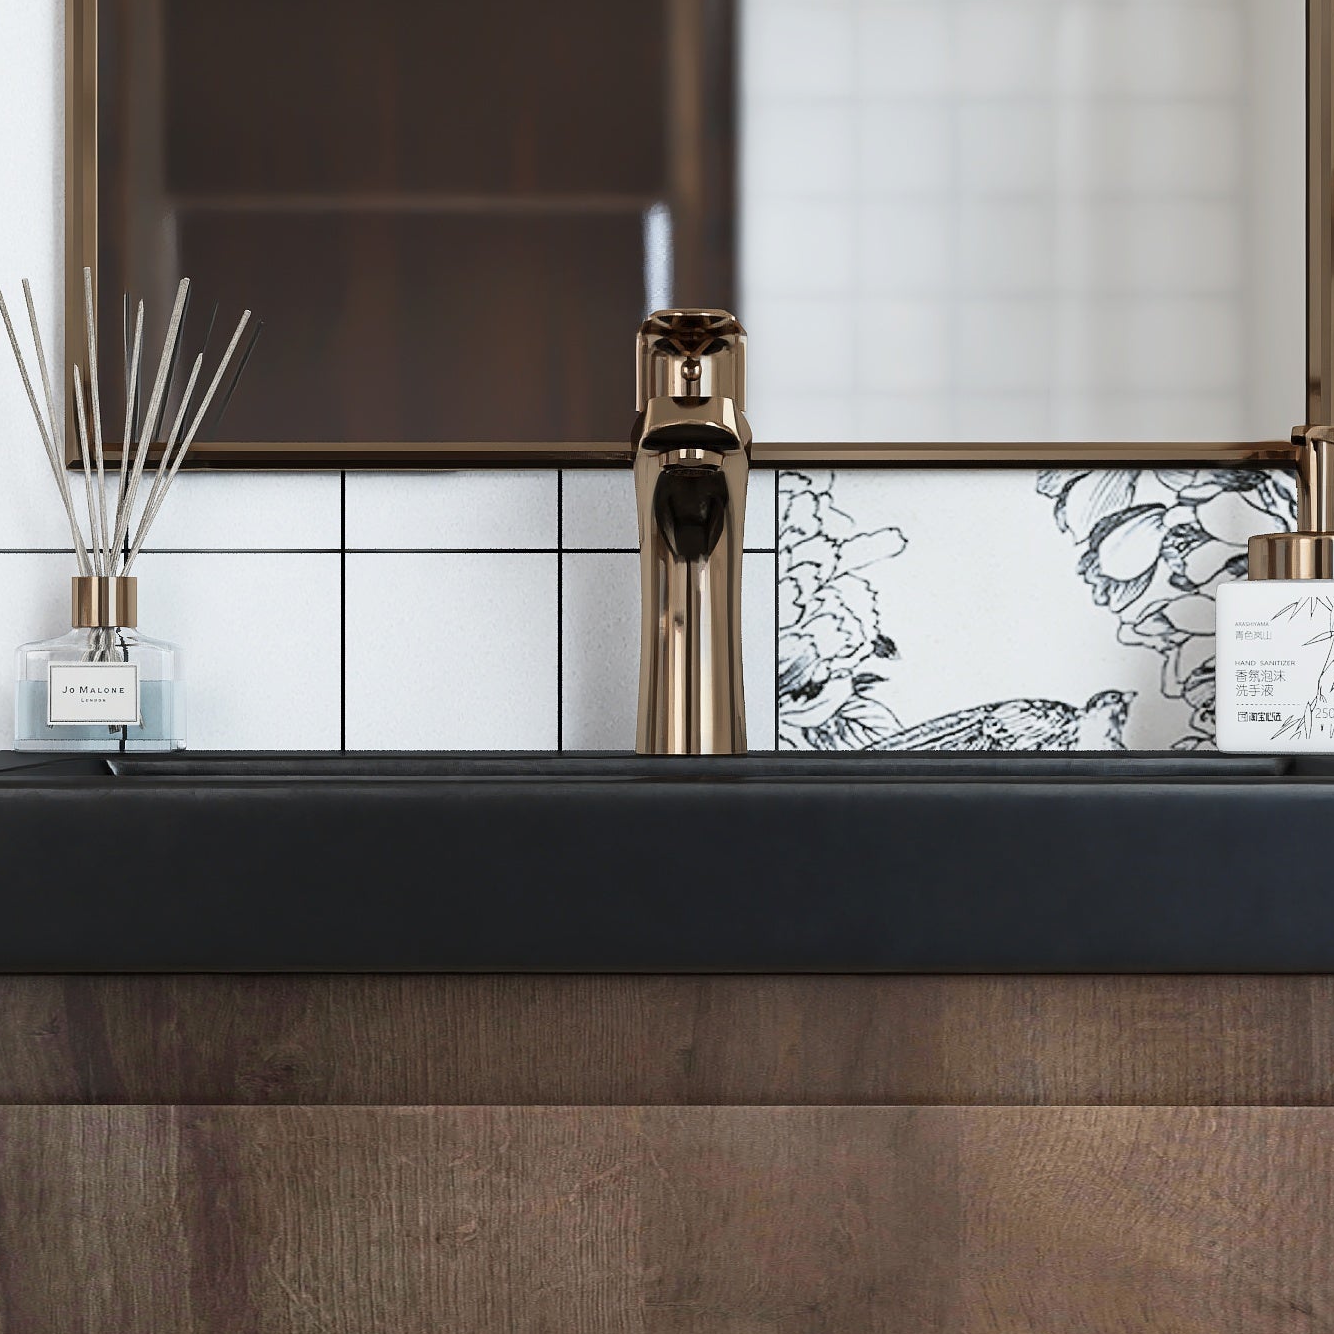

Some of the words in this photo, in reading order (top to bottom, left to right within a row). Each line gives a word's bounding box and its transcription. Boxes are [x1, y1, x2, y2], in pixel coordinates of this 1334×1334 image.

[1235, 669, 1286, 683] 香氛泡沫
[1235, 684, 1274, 697] 洗手液
